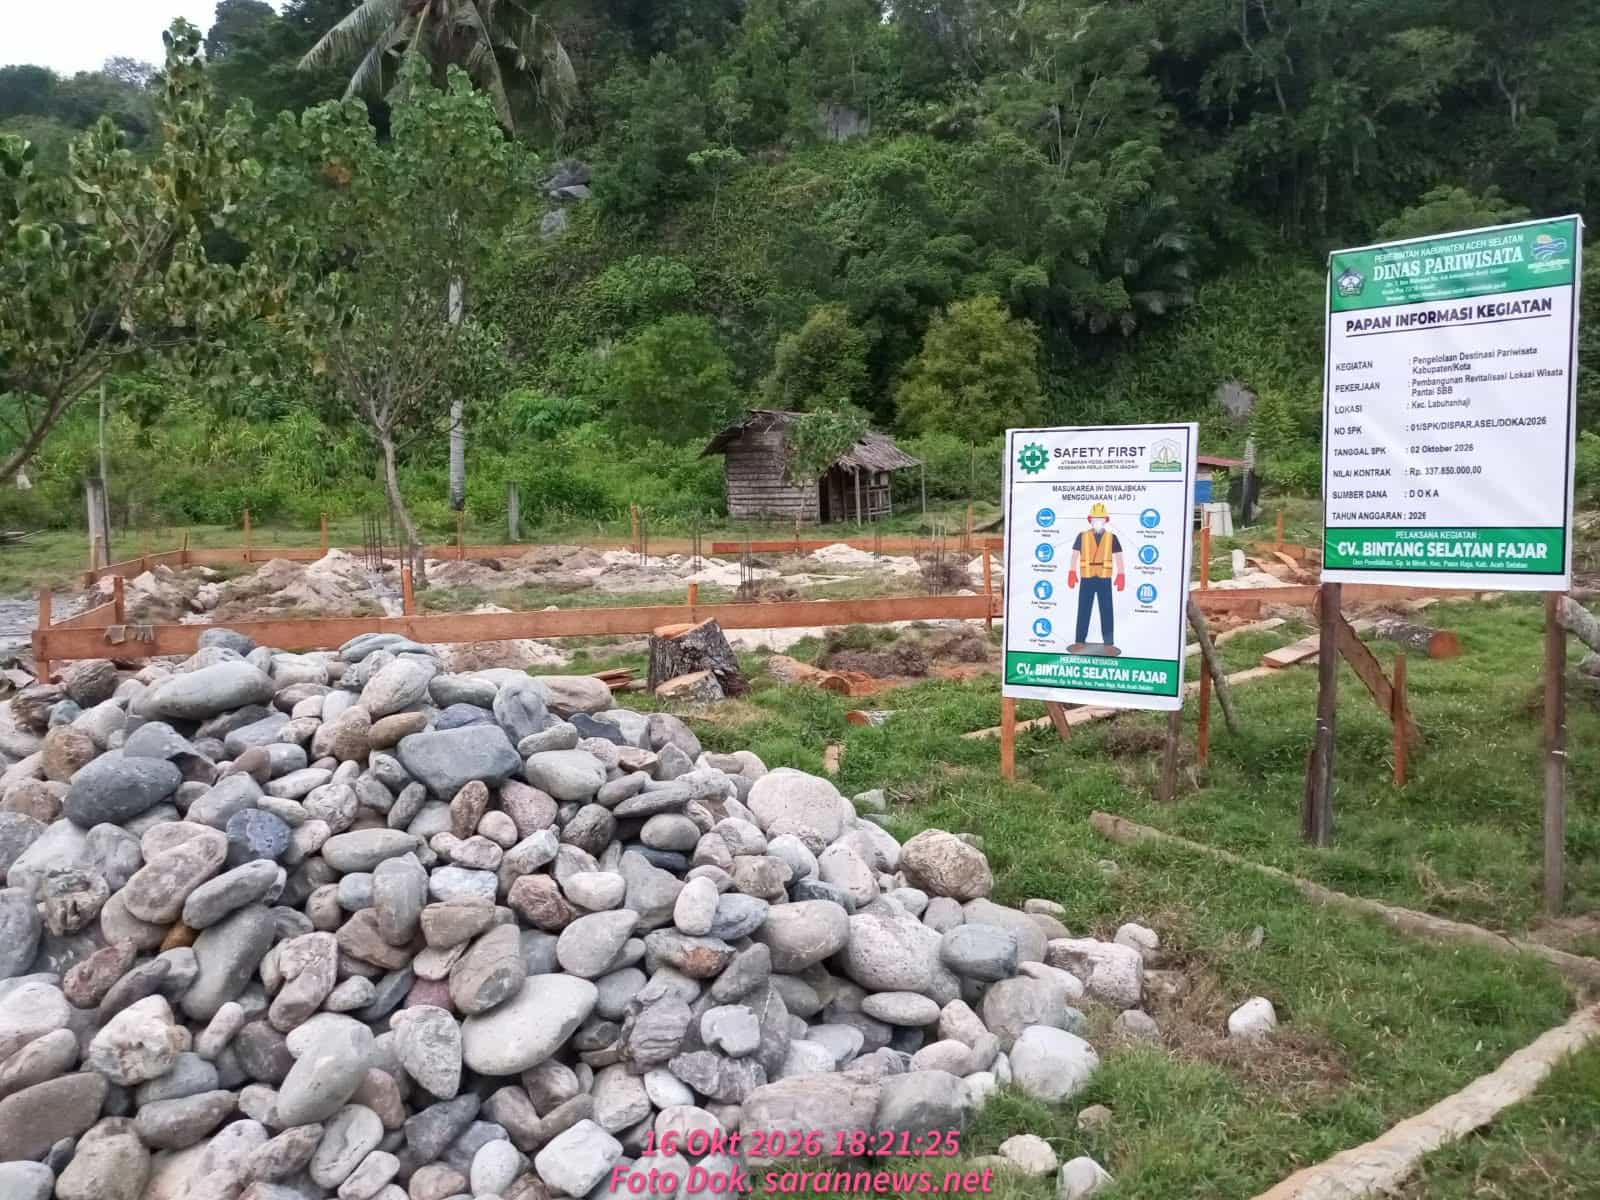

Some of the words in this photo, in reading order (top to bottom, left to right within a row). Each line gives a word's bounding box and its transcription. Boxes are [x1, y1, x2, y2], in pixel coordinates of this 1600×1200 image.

[1465, 240, 1487, 251] ACEH
[1488, 233, 1524, 247] SELATAN
[1373, 260, 1421, 281] DINAS
[1424, 245, 1524, 275] PARIWISATA
[1346, 315, 1391, 332] PAPAN
[1395, 307, 1473, 326] INFORMASI
[1476, 297, 1552, 319] KEGIATAN
[1335, 360, 1373, 372] KEGIATAN
[1412, 353, 1458, 366] Pengelolaan
[1459, 350, 1495, 361] Destinasi
[1497, 346, 1538, 357] Pariwisata
[1335, 381, 1380, 393] PEKERJAAN
[1411, 376, 1463, 387] Pembangunan
[1465, 372, 1507, 383] Revitalisasi
[1509, 369, 1535, 379] Lokasi
[1536, 368, 1563, 377] Wisata
[1411, 387, 1434, 397] Pantai
[1437, 385, 1453, 395] SBB
[1334, 403, 1363, 415] LOKASI
[1334, 426, 1345, 436] NO
[1347, 424, 1362, 435] SPK
[1053, 446, 1104, 459] SAFETY
[1107, 446, 1146, 457] FIRST
[1333, 447, 1369, 457] TANGGAL
[1371, 446, 1386, 455] SPK
[1410, 445, 1420, 454] 02
[1421, 444, 1452, 453] Oktober
[1454, 443, 1474, 452] 2026
[1332, 469, 1352, 478] NILAI
[1353, 467, 1391, 477] KONTRAK
[1052, 485, 1075, 493] MASUK
[1332, 490, 1364, 500] SUMBER
[1365, 489, 1388, 499] DANA
[1332, 511, 1357, 521] TAHUN
[1358, 511, 1402, 520] ANGGARAN
[1408, 511, 1427, 520] 2026
[1395, 530, 1438, 539] PELAKSANA
[1440, 531, 1477, 540] KEGIATAN
[1337, 541, 1359, 556] CV.
[1362, 541, 1424, 557] BINTANG
[1427, 542, 1493, 558] SELATAN
[1497, 542, 1548, 559] FAJAR
[1016, 662, 1033, 676] CV.
[1035, 663, 1080, 678] BINTANG
[1082, 666, 1130, 681] SELATAN
[1132, 670, 1168, 684] FAJAR
